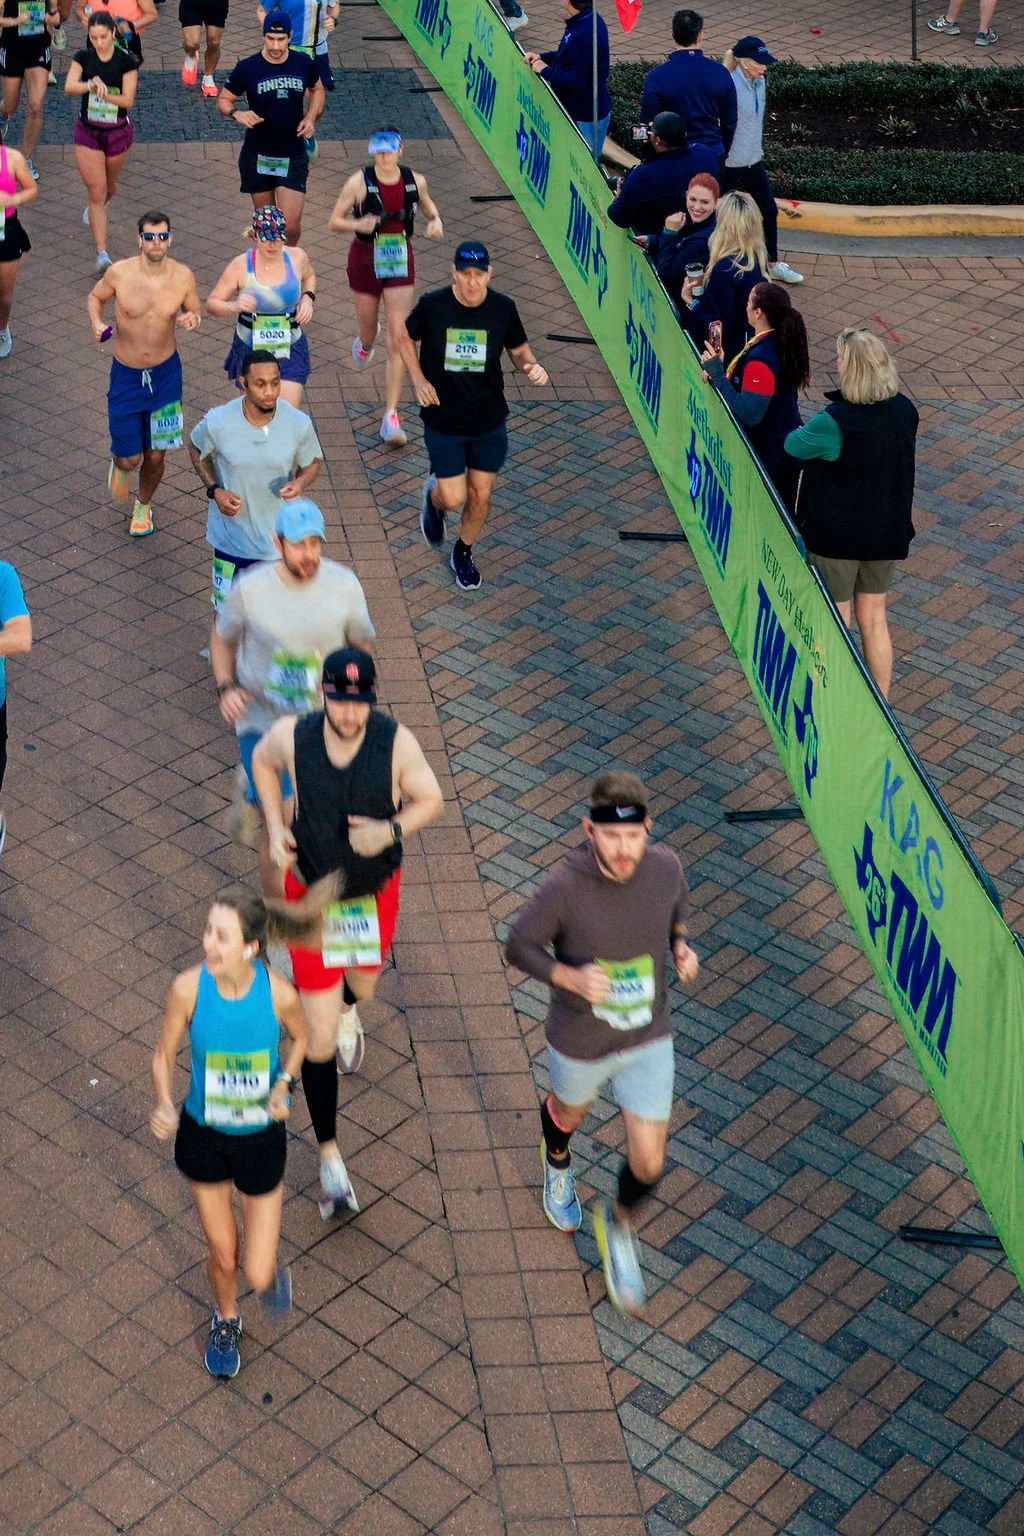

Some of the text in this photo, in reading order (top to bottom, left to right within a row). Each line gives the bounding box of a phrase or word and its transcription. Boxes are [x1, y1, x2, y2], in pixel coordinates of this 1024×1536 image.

[474, 4, 494, 59] KAG
[257, 76, 304, 95] FINISHER
[472, 55, 497, 128] TWM
[516, 82, 552, 148] Methodist
[526, 125, 552, 202] TWM
[565, 179, 592, 277] TWM
[630, 254, 656, 334] KAG
[260, 330, 285, 340] 5020
[455, 344, 478, 354] 2176
[637, 322, 663, 430] TWM
[687, 388, 733, 497] Methodist
[701, 451, 733, 571] TWM
[762, 537, 781, 578] NEW
[777, 573, 797, 617] DAY
[752, 577, 798, 737] TWM
[879, 755, 945, 912] KAG
[886, 869, 957, 1065] TWM
